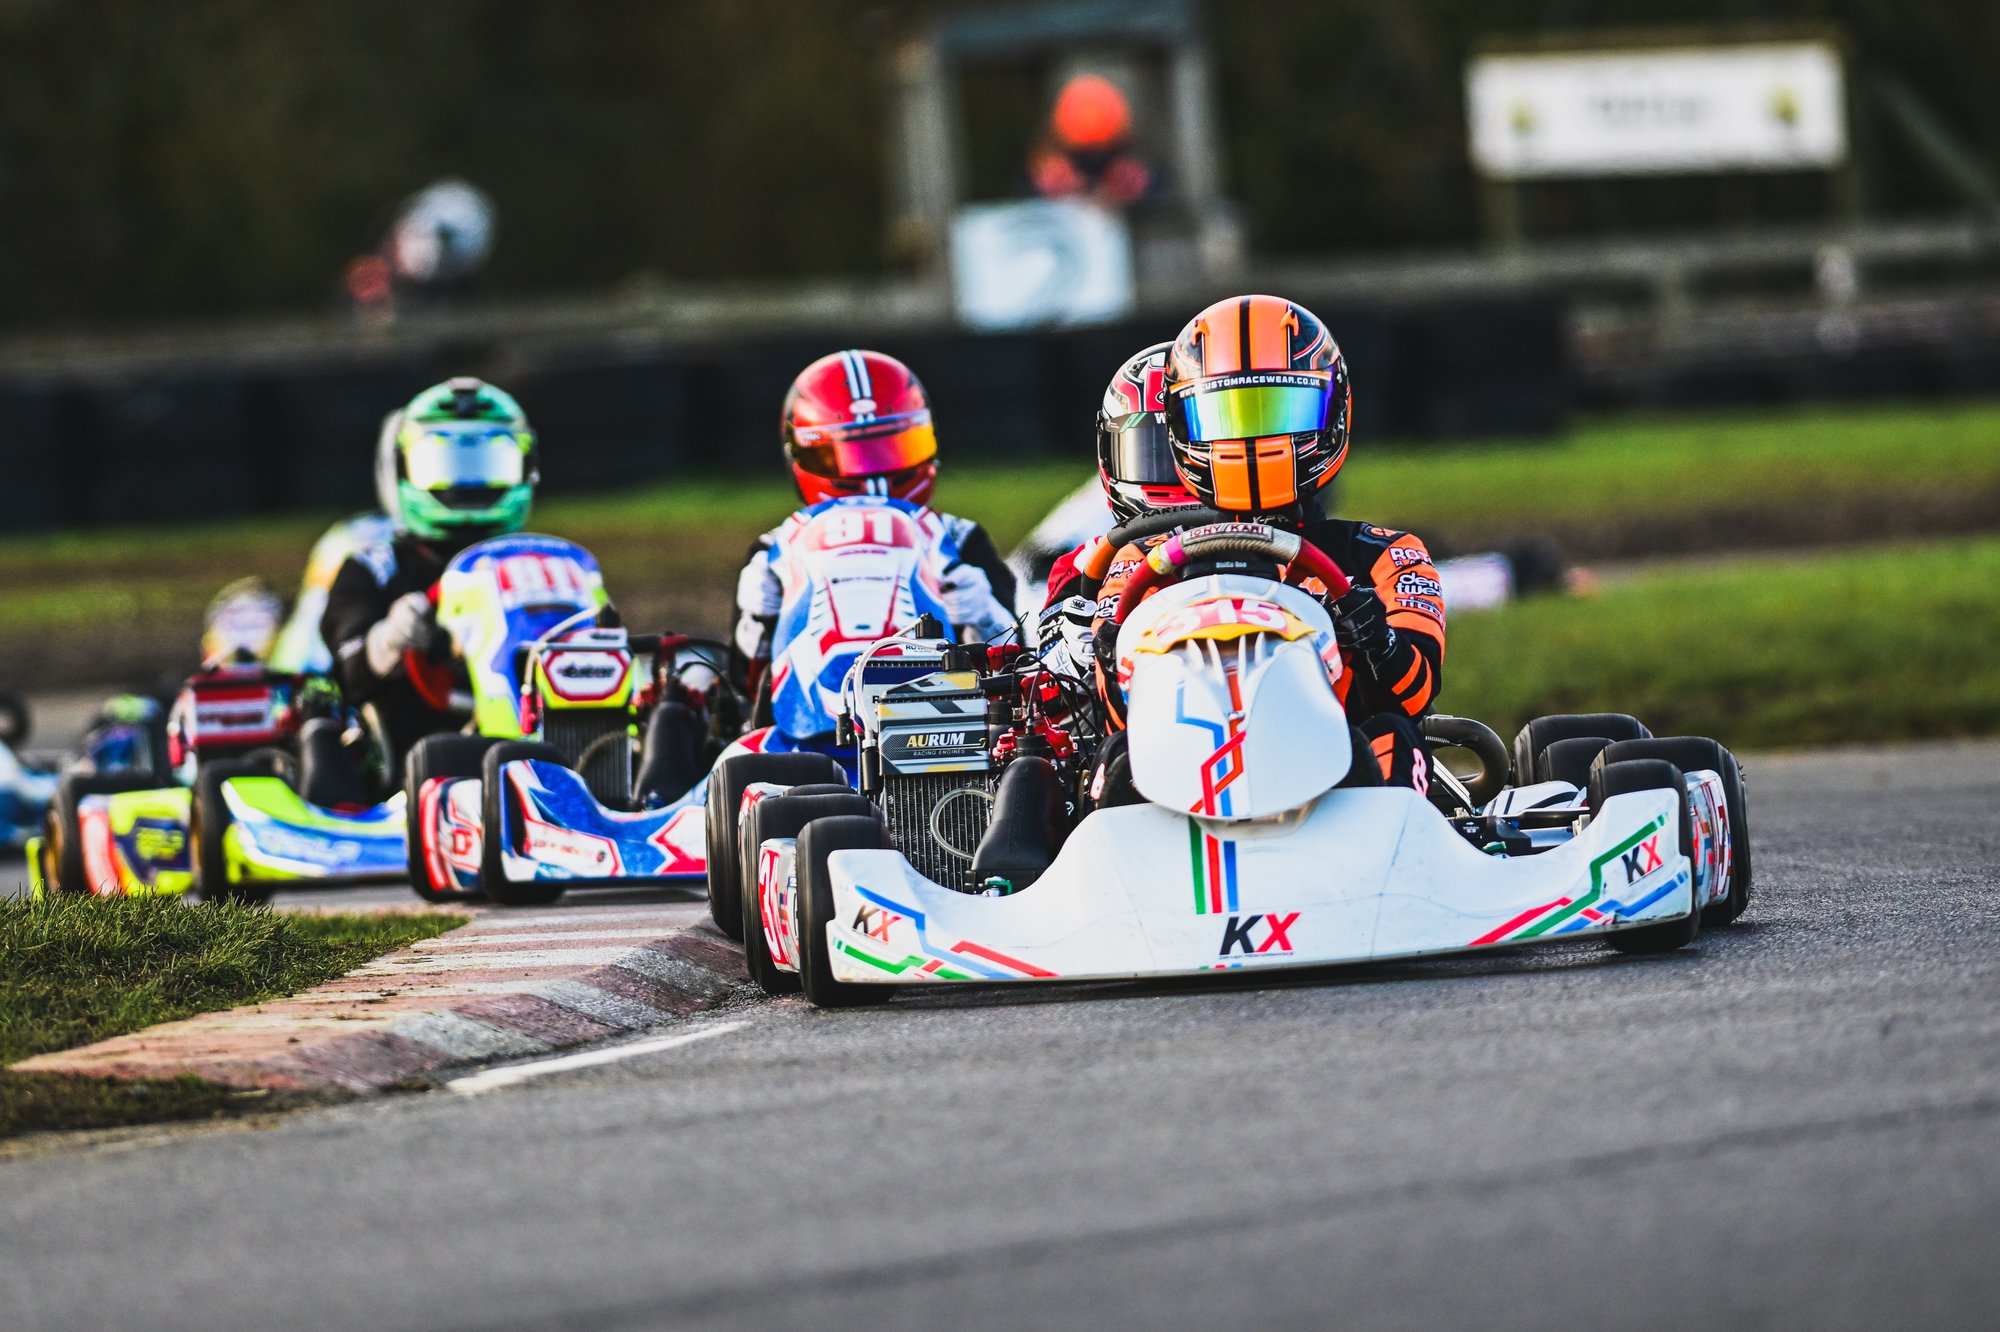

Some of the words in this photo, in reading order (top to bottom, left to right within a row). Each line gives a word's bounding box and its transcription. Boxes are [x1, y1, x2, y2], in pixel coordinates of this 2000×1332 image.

[1156, 598, 1288, 642] 315
[906, 732, 966, 748] AURUM
[913, 749, 936, 757] RACING
[938, 748, 966, 756] ENGINES
[852, 903, 903, 943] KX
[1218, 911, 1303, 956] KX
